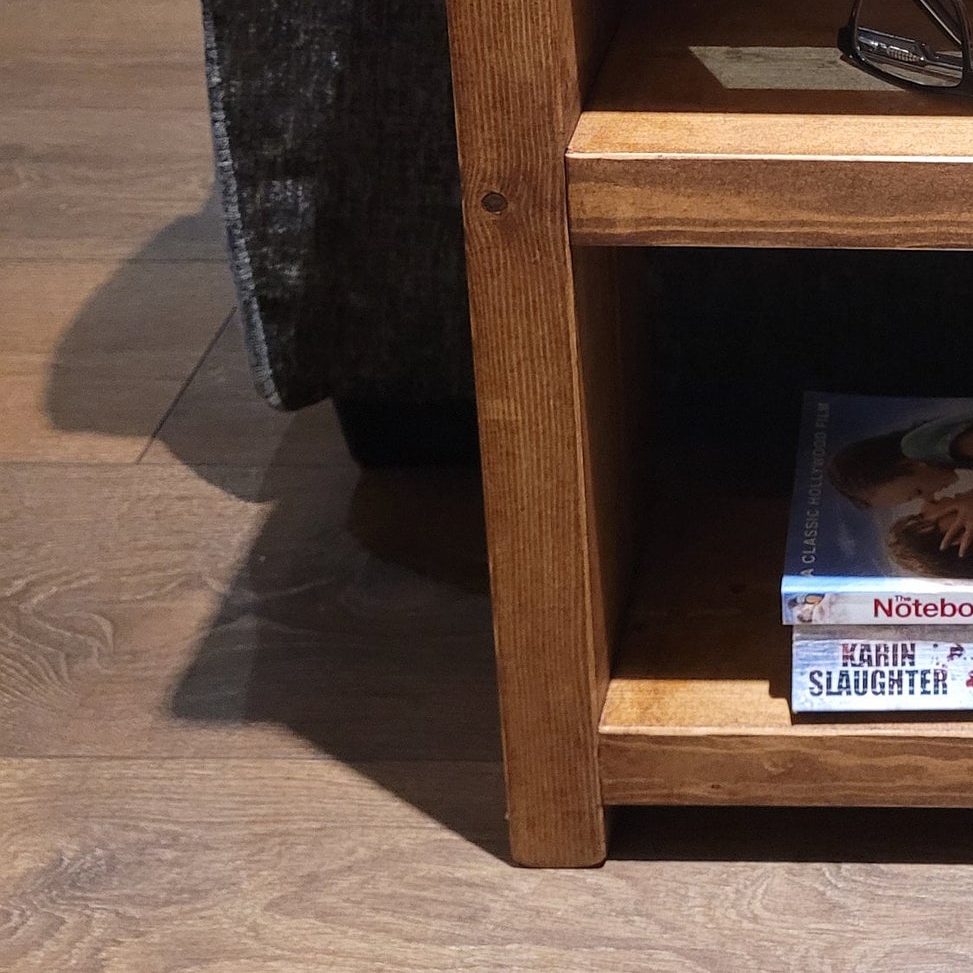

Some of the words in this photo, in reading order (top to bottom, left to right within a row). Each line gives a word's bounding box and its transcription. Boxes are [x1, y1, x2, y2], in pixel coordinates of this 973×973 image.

[816, 402, 831, 429] FILM
[808, 431, 828, 506] HOLLYWOOD
[802, 508, 820, 564] CLASSIC
[800, 567, 814, 577] A
[842, 643, 916, 668] KARIN
[808, 669, 948, 696] SLAUGHTER
